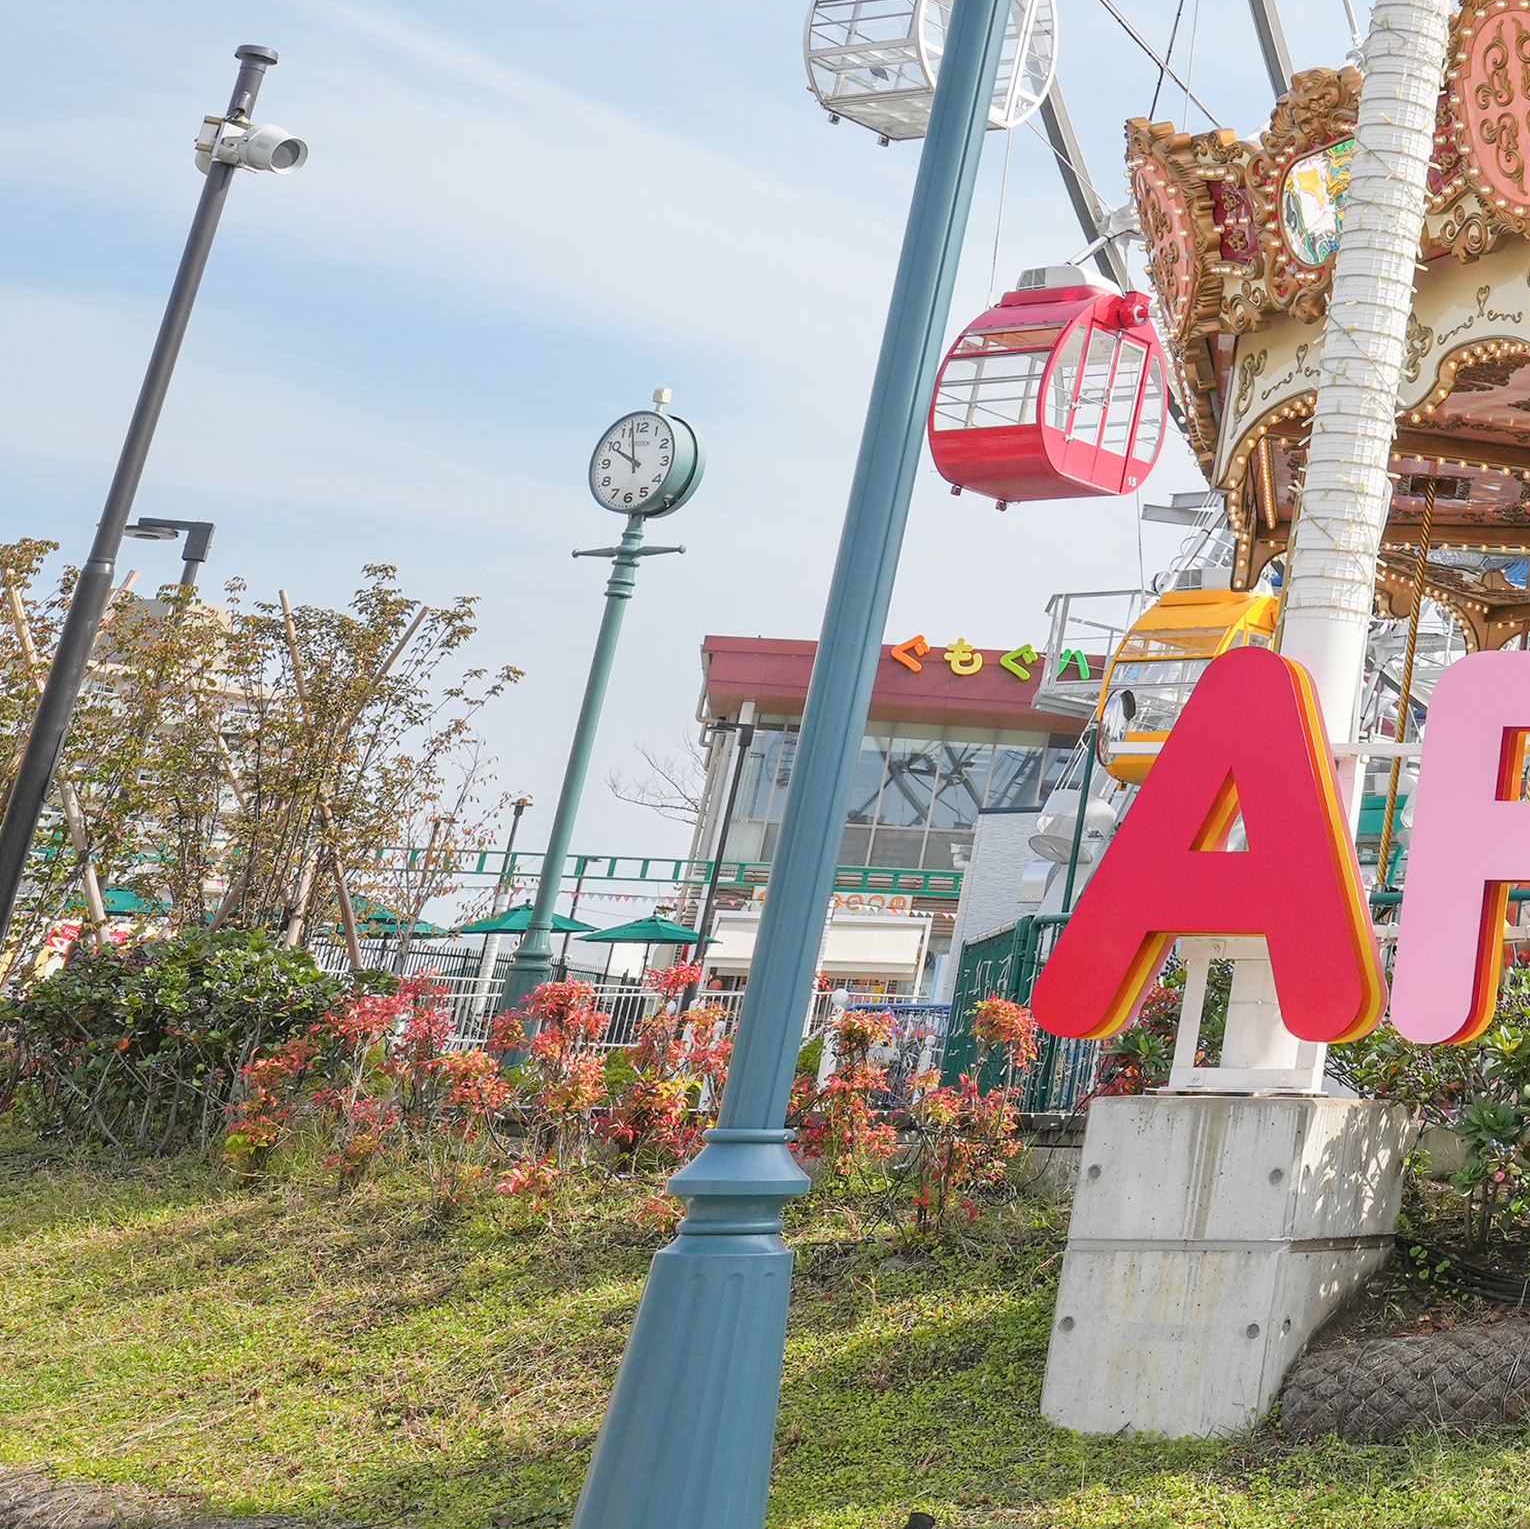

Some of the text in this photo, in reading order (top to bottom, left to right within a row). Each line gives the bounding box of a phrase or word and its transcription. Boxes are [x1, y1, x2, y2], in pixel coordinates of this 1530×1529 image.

[1017, 99, 1028, 111] 14
[636, 422, 649, 433] 12
[654, 426, 659, 437] 1
[608, 440, 621, 452] 10
[628, 440, 650, 448] CTIZEN
[659, 438, 669, 449] 2
[601, 458, 611, 469] 9
[660, 455, 670, 466] 3
[601, 476, 611, 487] 8
[651, 473, 662, 484] 4
[1127, 476, 1138, 488] 15
[611, 488, 620, 500] 7
[623, 492, 634, 503] 6
[639, 486, 649, 498] 5
